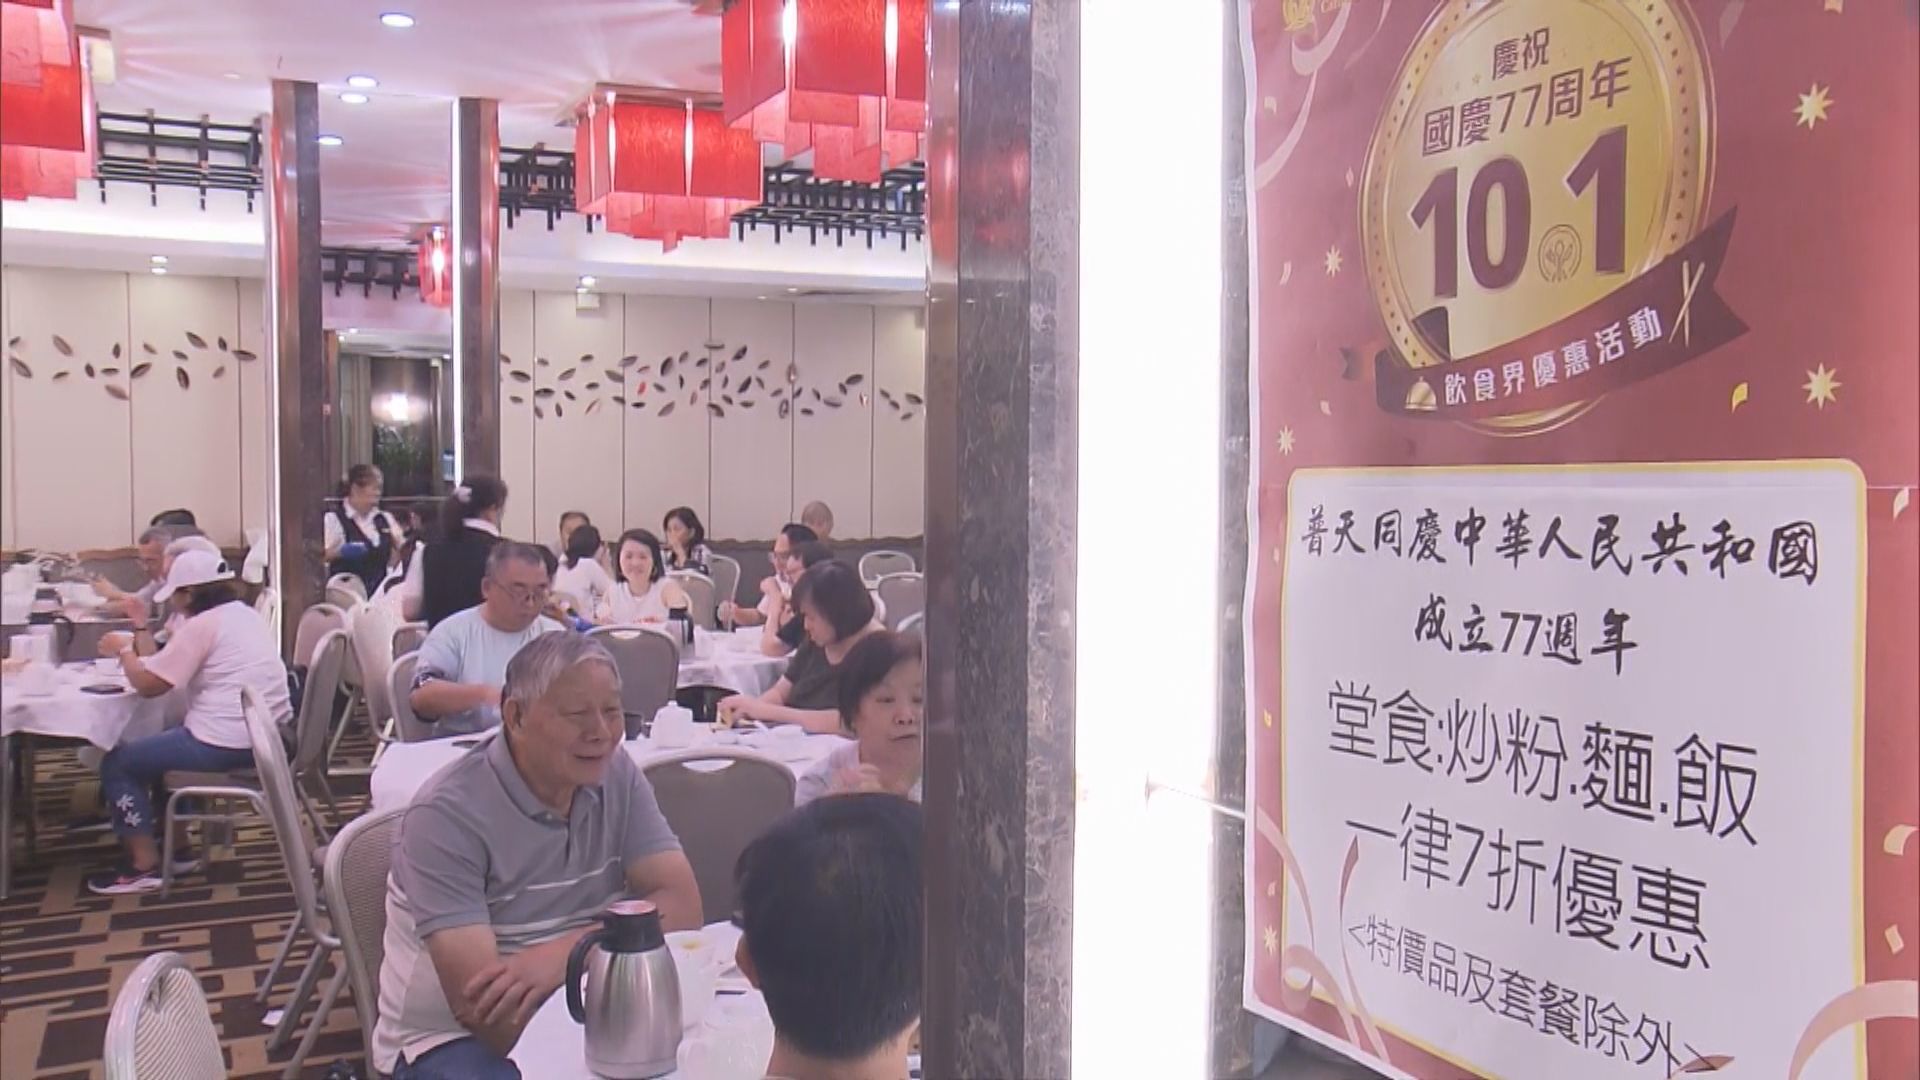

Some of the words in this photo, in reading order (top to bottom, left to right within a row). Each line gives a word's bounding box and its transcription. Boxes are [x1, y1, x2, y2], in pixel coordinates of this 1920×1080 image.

[1491, 27, 1550, 80] 慶祝
[1421, 56, 1633, 156] 國慶77周年
[1444, 306, 1663, 405] 飲食界優惠活動
[1345, 803, 1711, 970] 一律7折優惠
